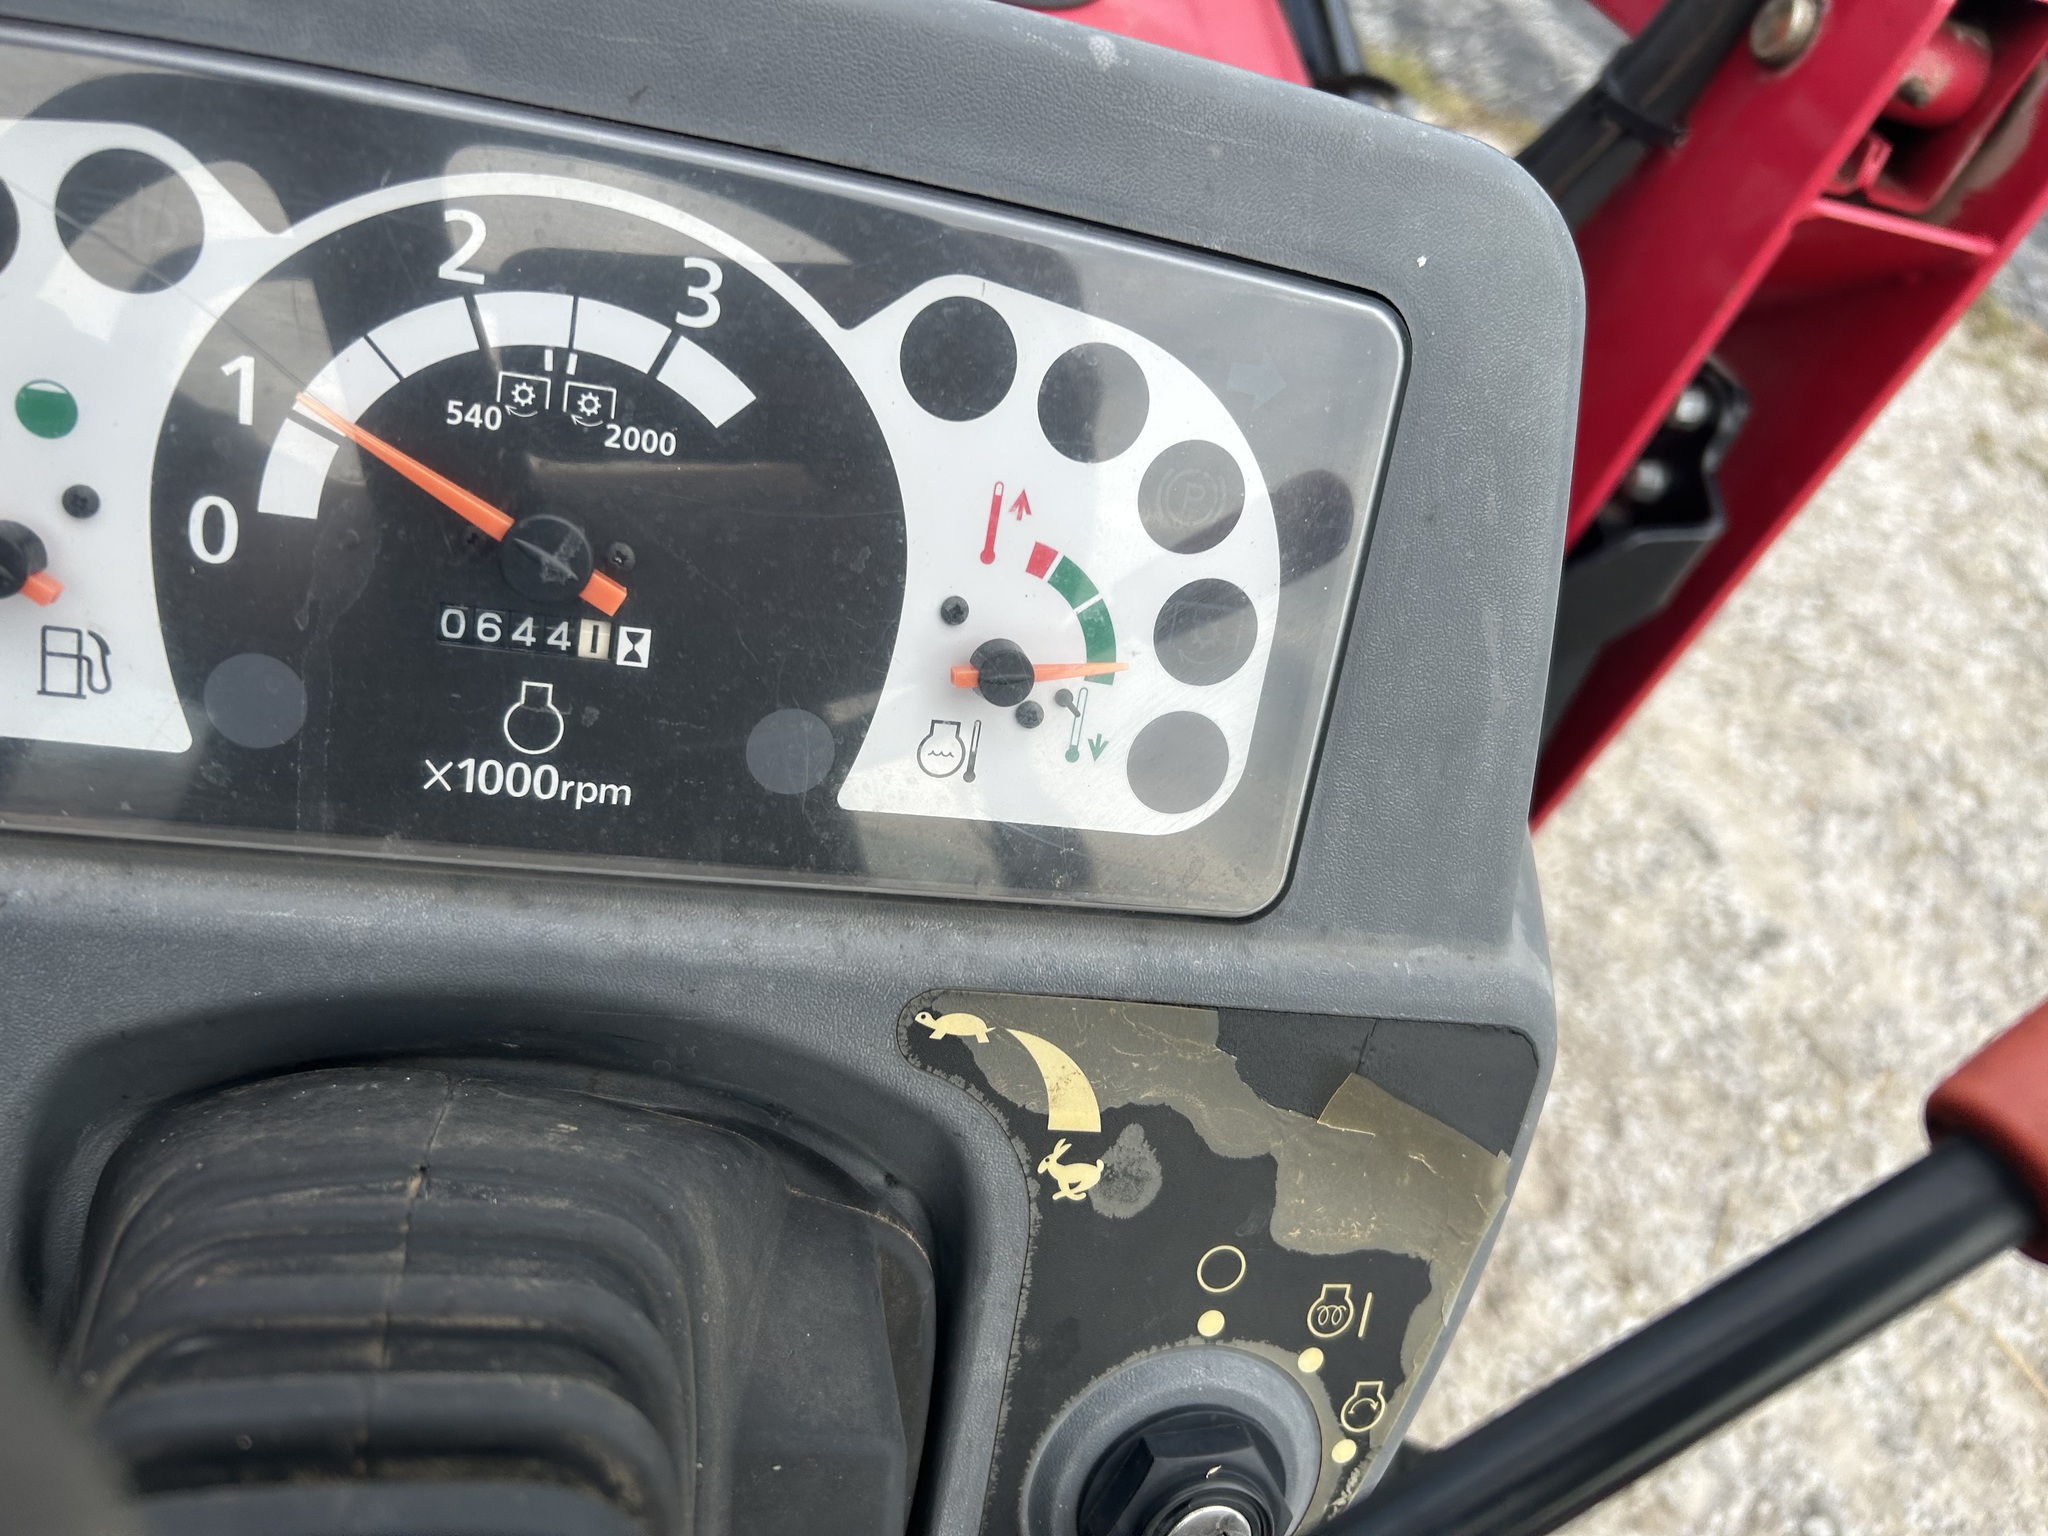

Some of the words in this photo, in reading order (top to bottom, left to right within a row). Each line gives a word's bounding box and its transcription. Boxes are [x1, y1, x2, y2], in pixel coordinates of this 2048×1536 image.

[437, 210, 486, 285] 2
[675, 257, 723, 328] 3
[221, 355, 255, 425] 1
[445, 400, 502, 431] 540
[604, 424, 677, 456] 2000
[188, 495, 239, 563] 0
